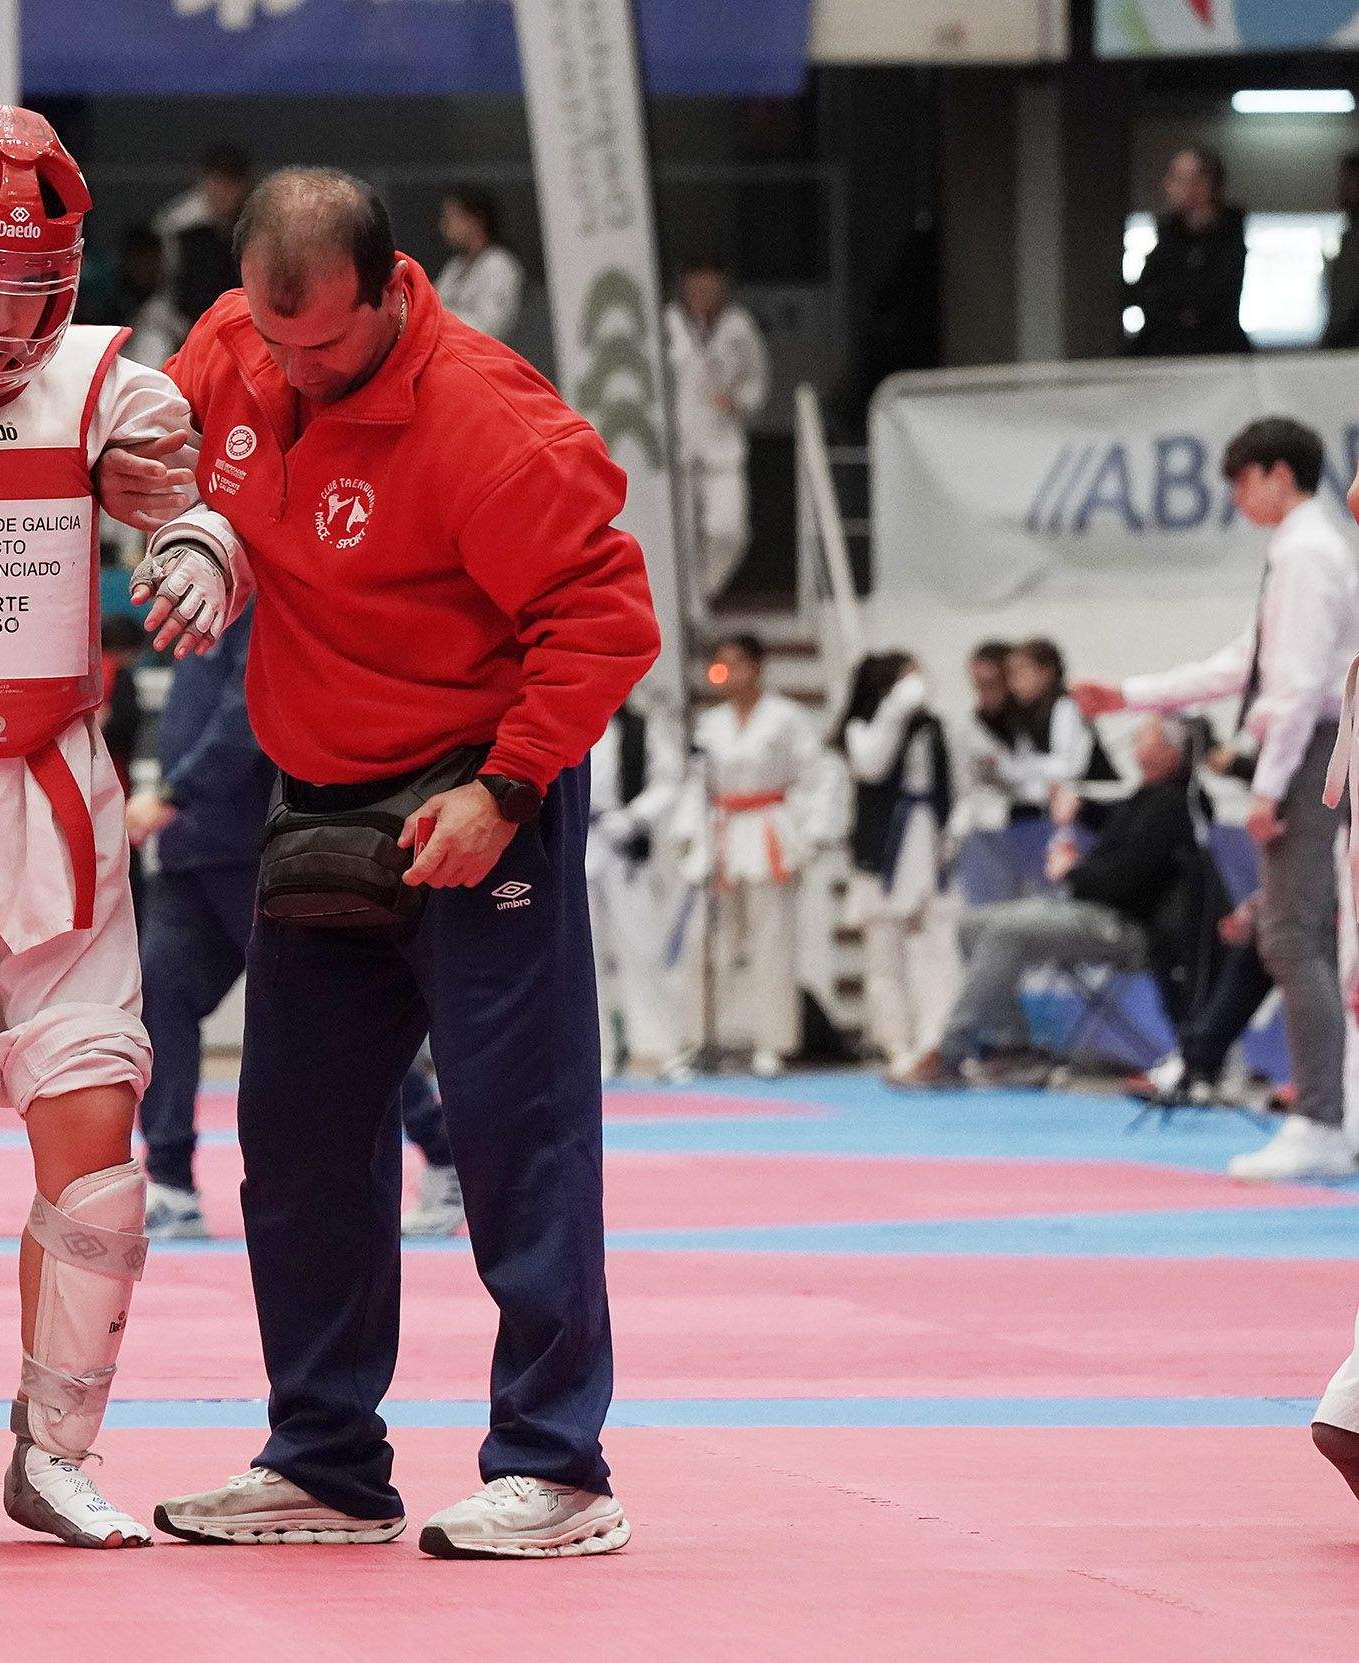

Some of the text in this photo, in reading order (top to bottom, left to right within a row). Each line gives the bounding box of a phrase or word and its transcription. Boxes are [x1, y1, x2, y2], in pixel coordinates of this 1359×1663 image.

[321, 480, 338, 499] CLUB
[22, 515, 81, 532] GALICIA
[336, 528, 366, 549] SPORT
[496, 898, 531, 910] umbro
